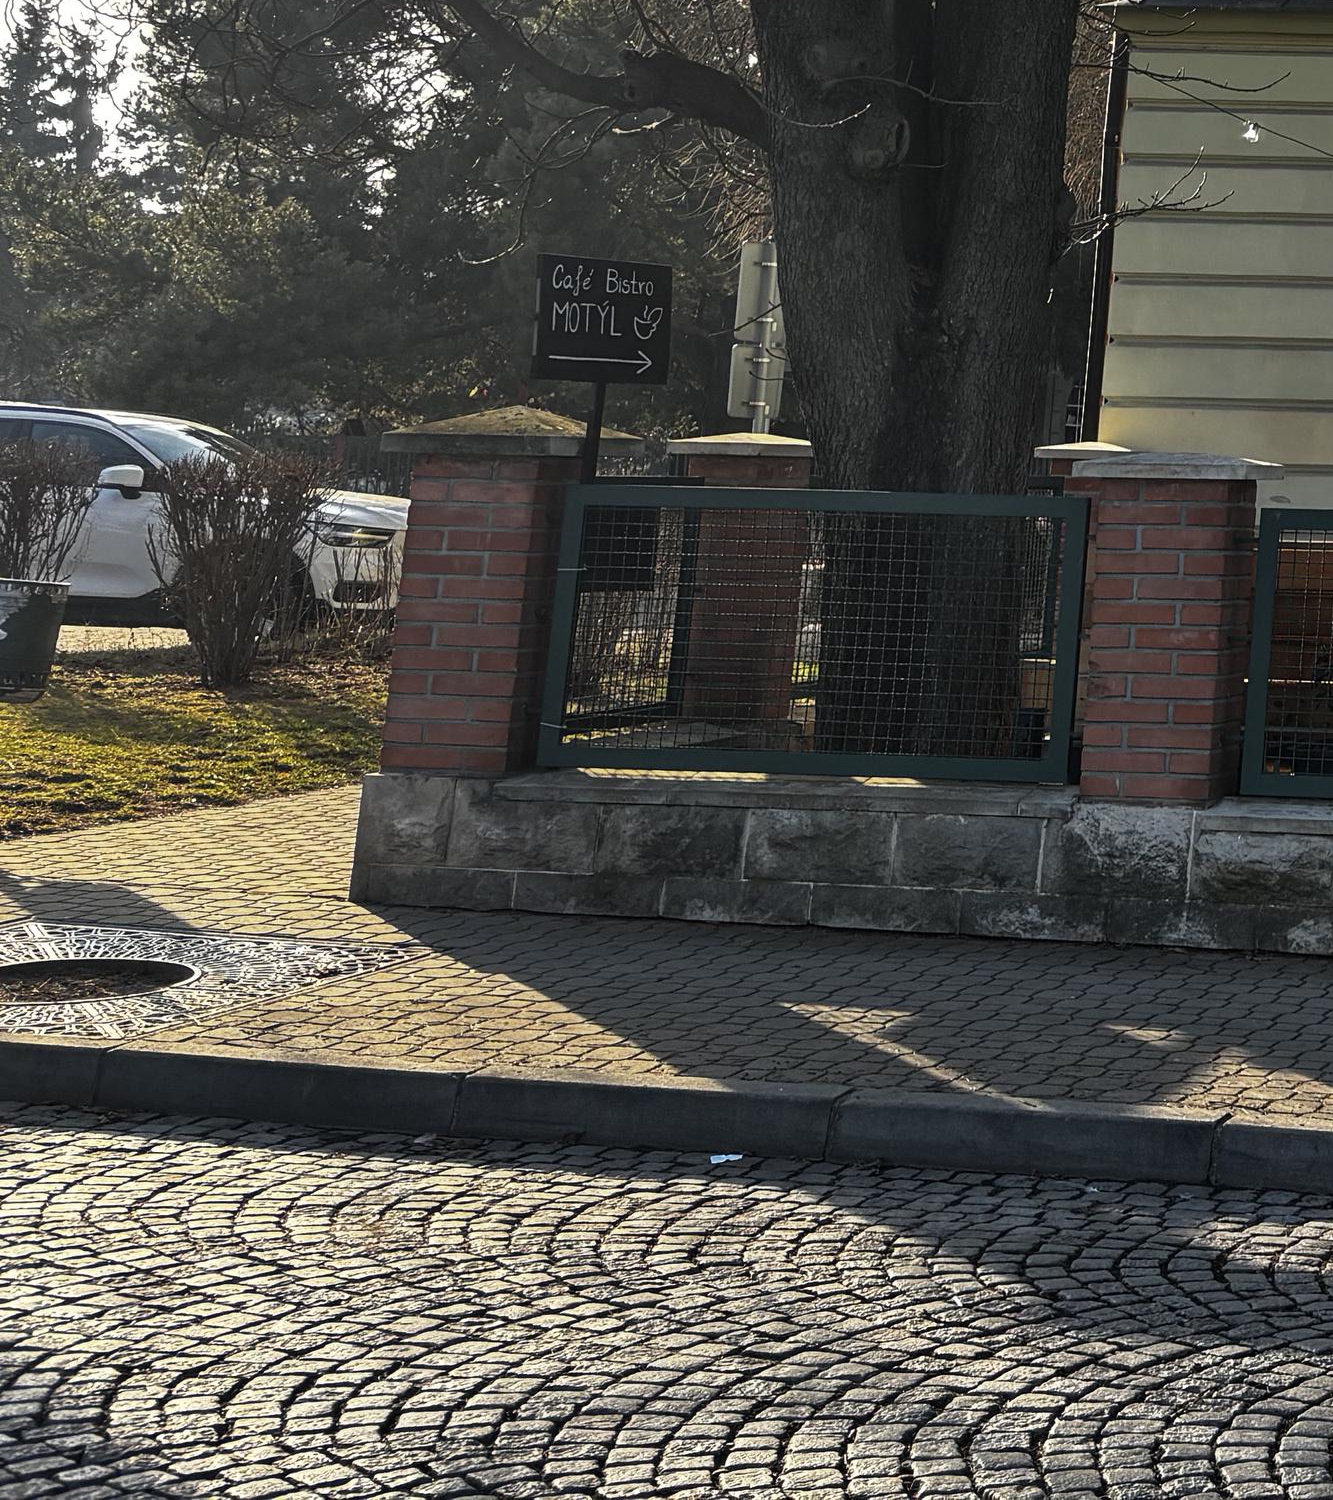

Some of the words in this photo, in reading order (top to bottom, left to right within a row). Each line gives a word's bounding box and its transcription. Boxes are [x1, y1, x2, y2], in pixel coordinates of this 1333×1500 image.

[552, 263, 595, 297] Café
[606, 268, 654, 297] Bistro
[551, 300, 622, 337] MOTÝL
